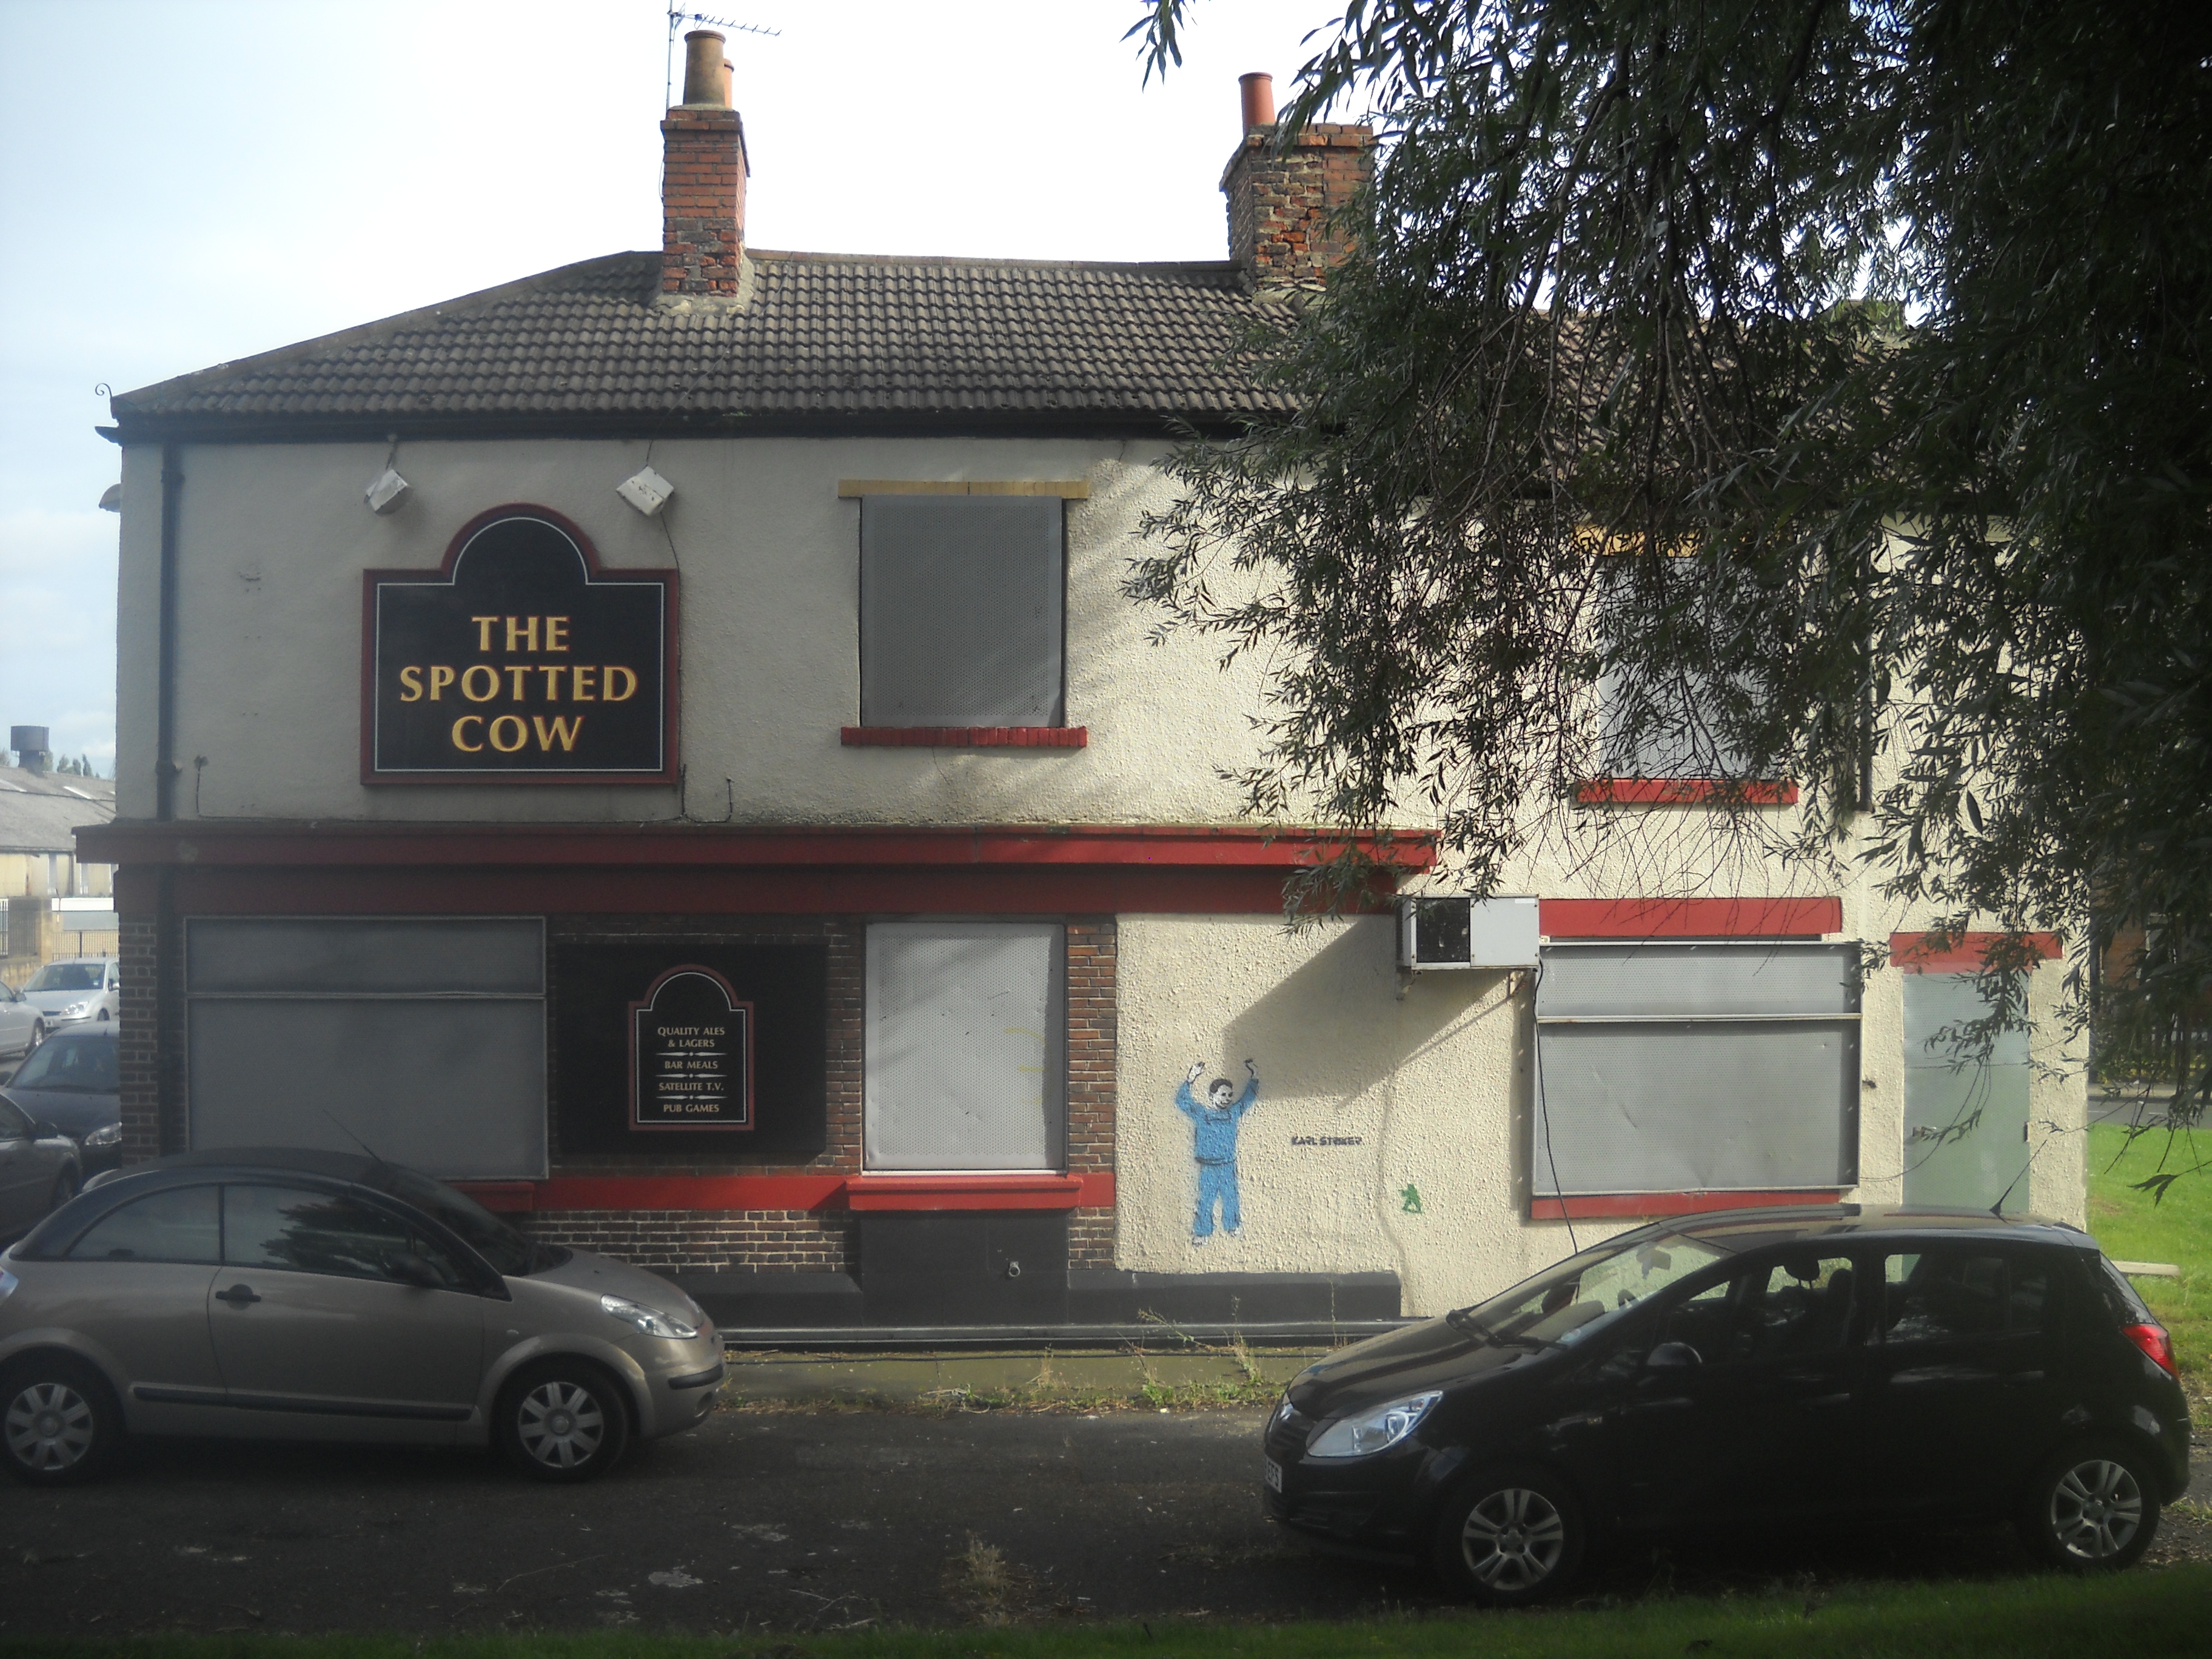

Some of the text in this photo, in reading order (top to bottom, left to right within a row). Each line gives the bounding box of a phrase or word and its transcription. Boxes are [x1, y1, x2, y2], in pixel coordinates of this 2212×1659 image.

[472, 615, 570, 652] THE
[400, 665, 638, 702] SPOTTED
[452, 715, 585, 752] COW
[657, 1027, 725, 1037] QUALITY ALES
[679, 1039, 715, 1047] LAGERS
[665, 1061, 718, 1069] BAR MEALS
[659, 1082, 724, 1091] SATELLITE T.V.
[1292, 1136, 1318, 1145] KARL
